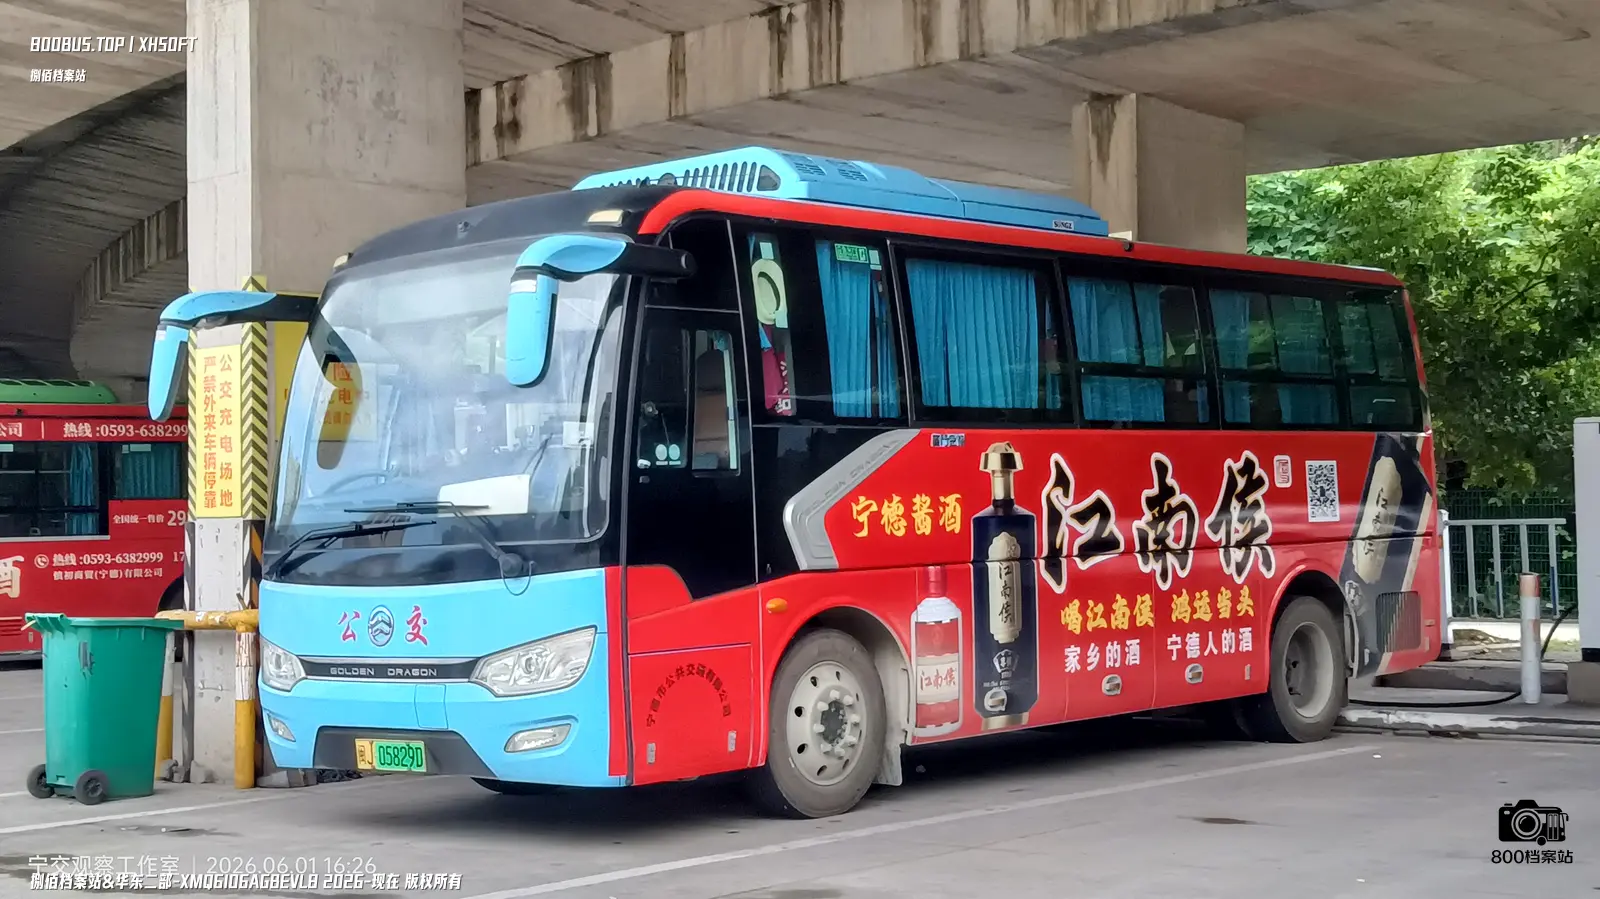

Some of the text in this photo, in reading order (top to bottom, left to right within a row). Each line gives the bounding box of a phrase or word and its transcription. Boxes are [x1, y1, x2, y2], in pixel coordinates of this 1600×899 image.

[203, 355, 217, 509] 严禁外来车辆停靠
[219, 353, 233, 508] 公交充电场地
[850, 493, 962, 538] 宁德酱酒
[1040, 450, 1276, 594] 江南侯
[1061, 585, 1255, 635] 喝江南侯 鸿运当头
[330, 667, 437, 677] GOLDEN DRAGON
[1064, 627, 1253, 674] 家乡的酒 宁德人的酒
